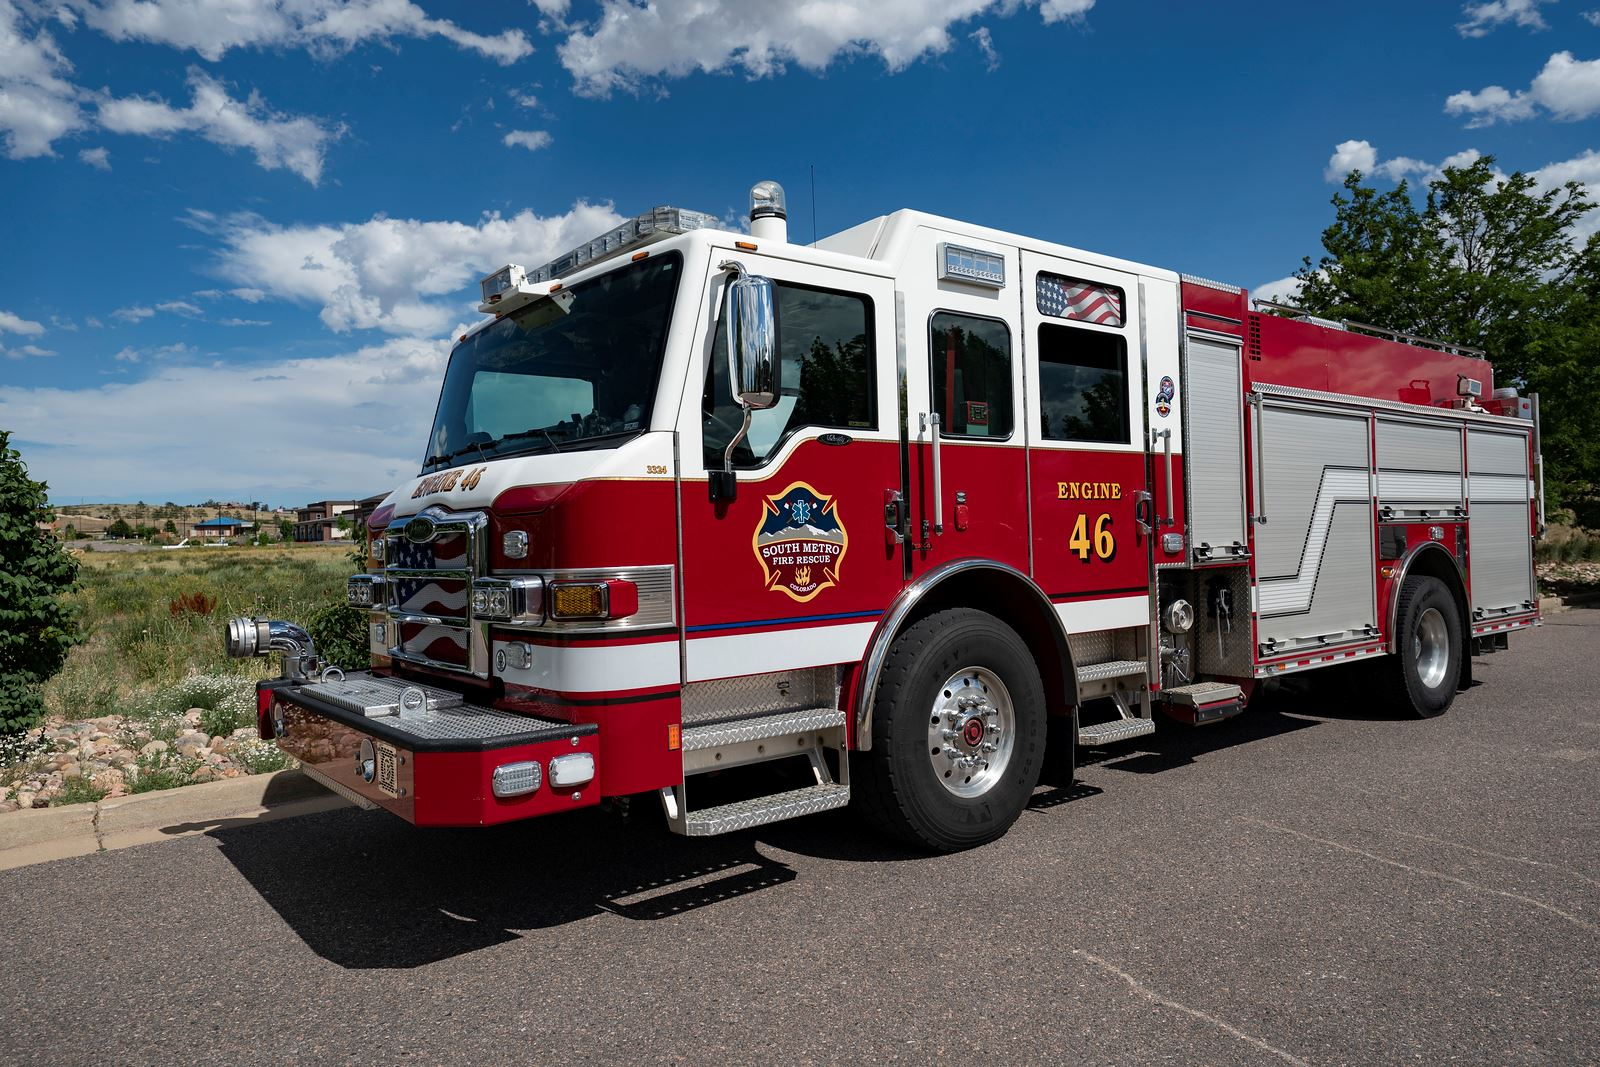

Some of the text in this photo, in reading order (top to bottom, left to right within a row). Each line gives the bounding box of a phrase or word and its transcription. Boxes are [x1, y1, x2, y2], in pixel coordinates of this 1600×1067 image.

[646, 465, 668, 474] 3324
[460, 467, 487, 492] 46
[1057, 482, 1121, 499] ENGINE
[1069, 513, 1115, 561] 46
[763, 543, 840, 558] SOUTH METRO
[773, 555, 831, 565] FIRE RESCUE
[789, 583, 817, 592] COLORADO
